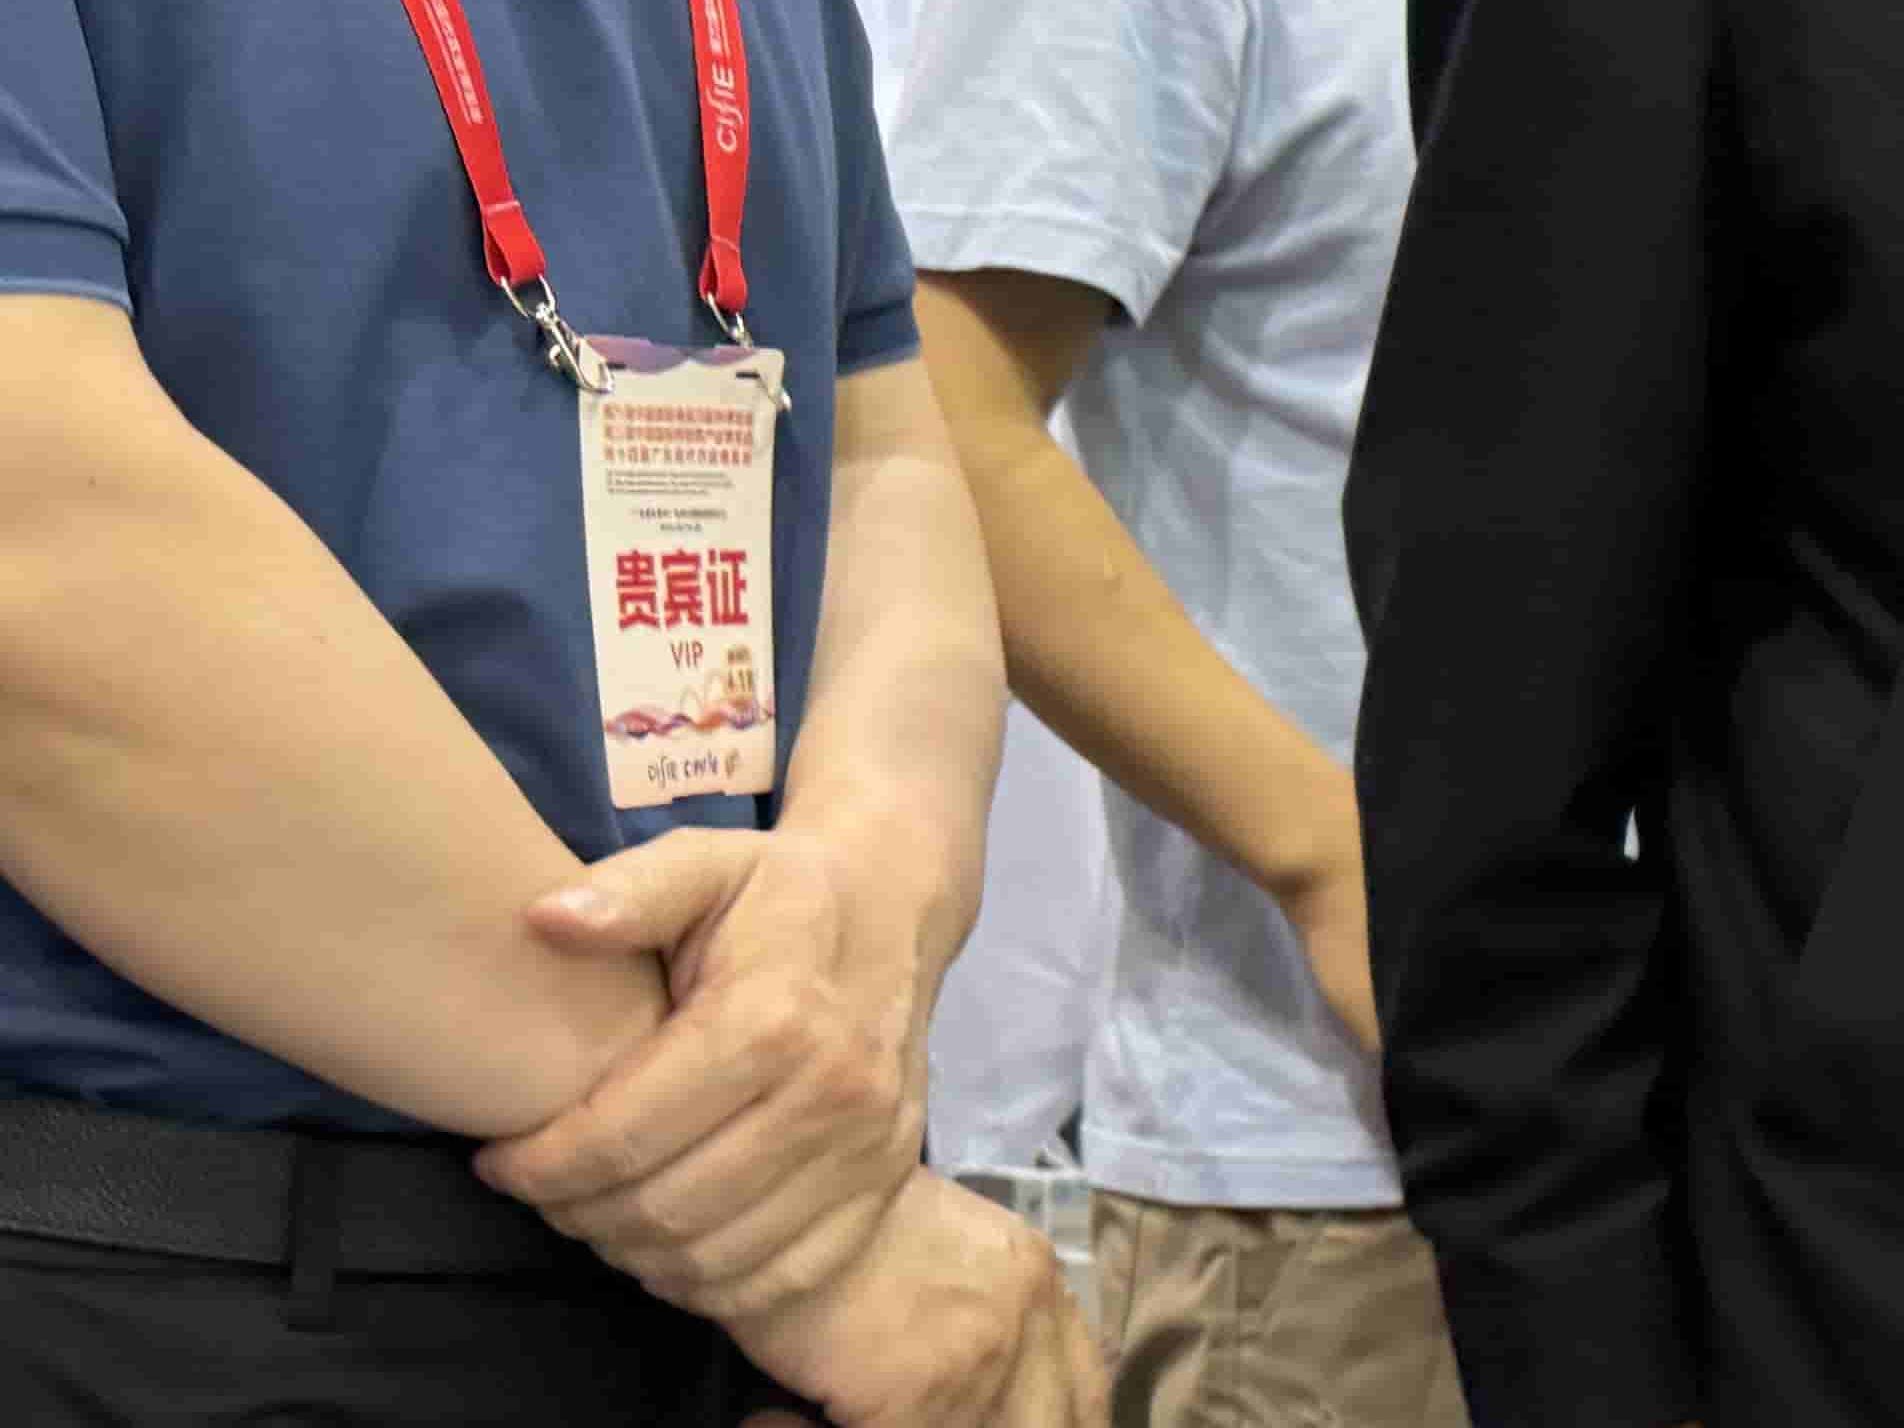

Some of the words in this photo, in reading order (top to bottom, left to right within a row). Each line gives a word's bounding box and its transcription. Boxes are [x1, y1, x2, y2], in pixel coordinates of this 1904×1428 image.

[614, 548, 750, 631] 贵宾证
[670, 640, 704, 669] VIP
